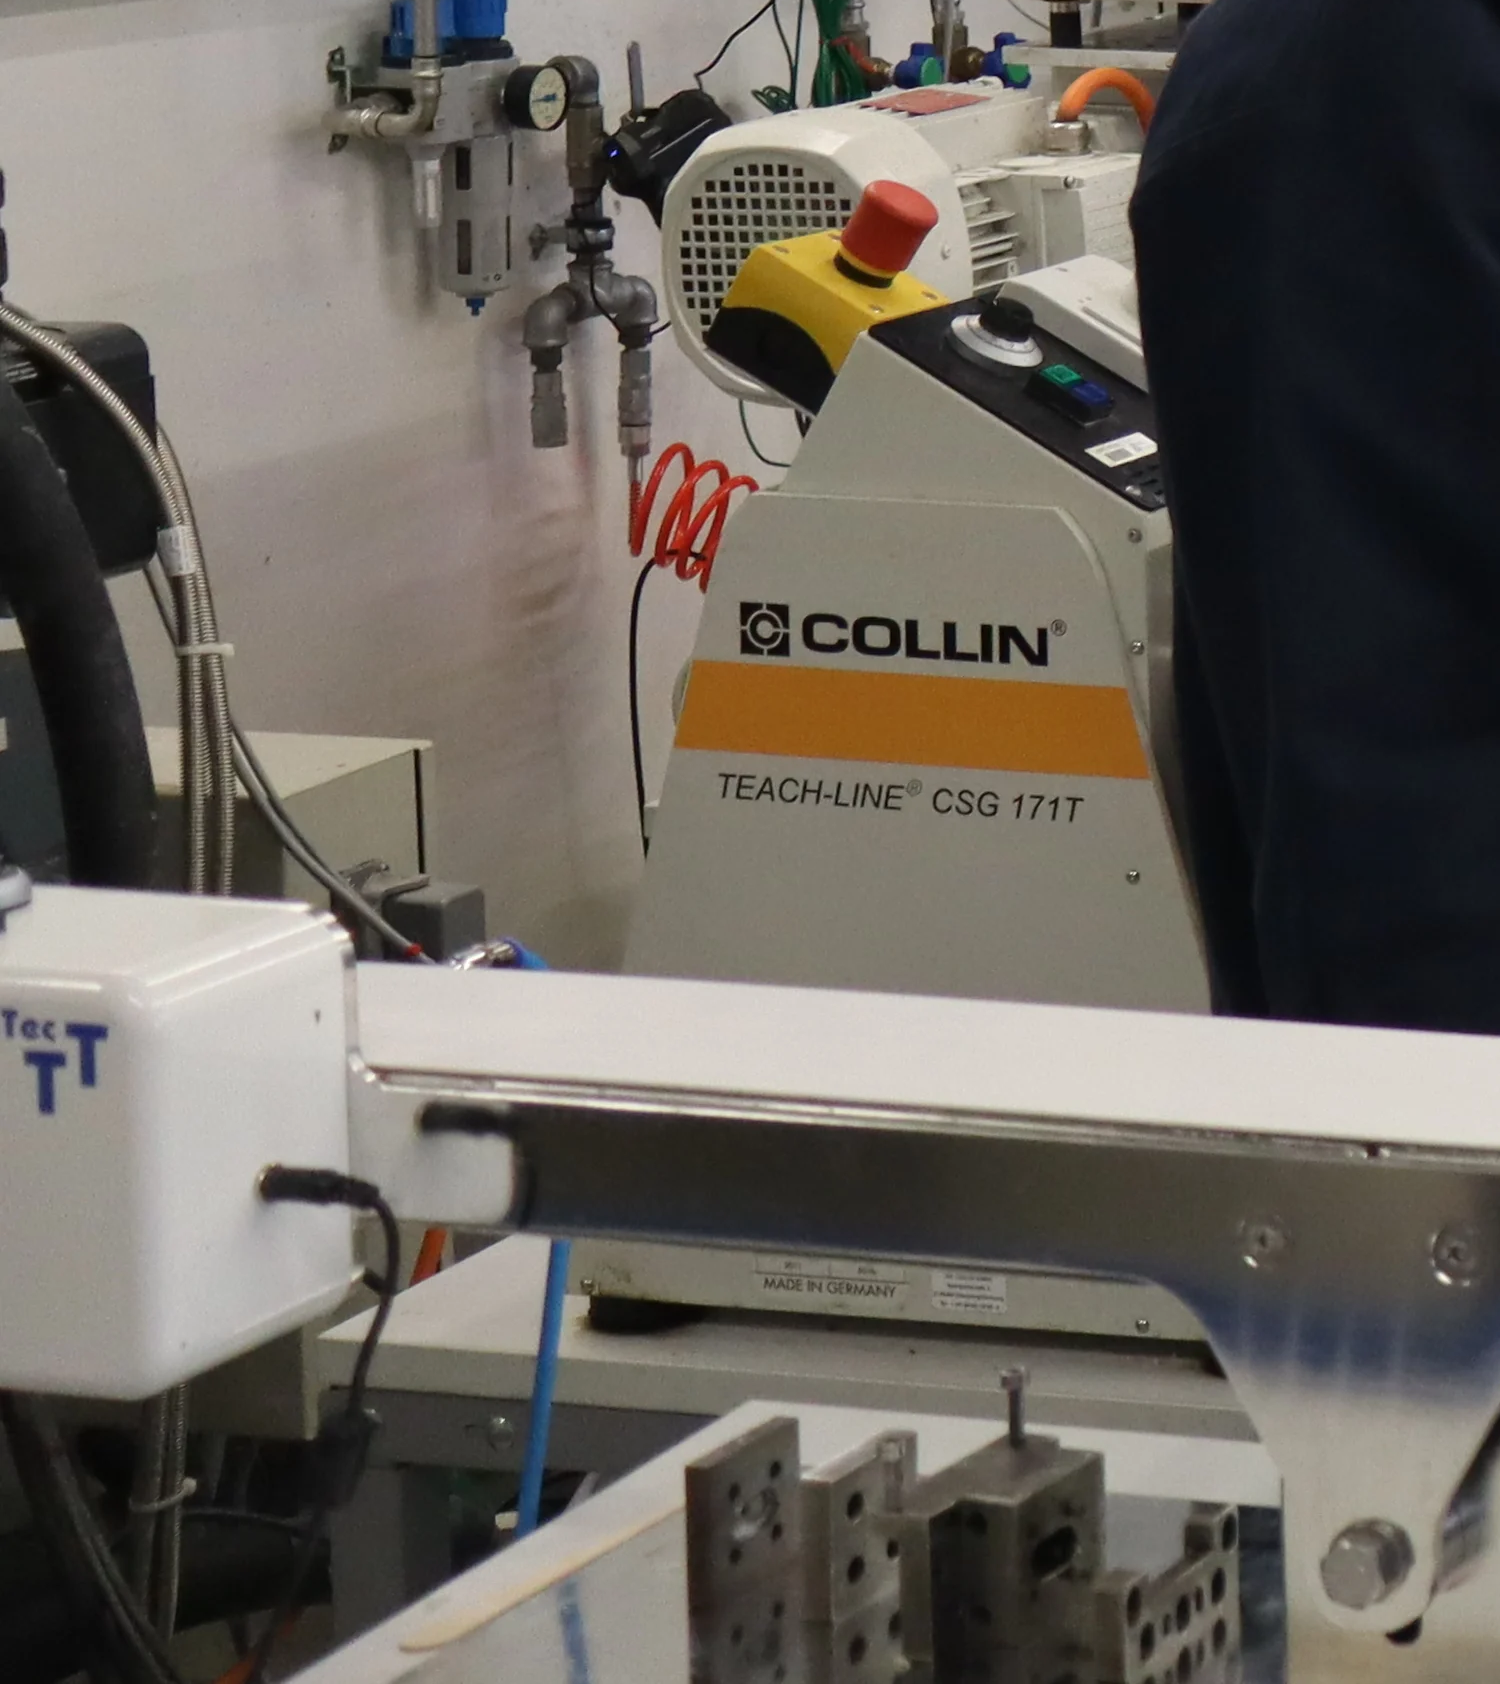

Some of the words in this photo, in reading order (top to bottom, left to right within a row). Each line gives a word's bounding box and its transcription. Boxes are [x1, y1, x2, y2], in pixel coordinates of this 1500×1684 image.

[931, 787, 1000, 818] CSG
[1012, 793, 1085, 823] 171T
[763, 1277, 803, 1293] MADE
[806, 1279, 823, 1294] IN
[826, 1280, 897, 1298] GERMANY
